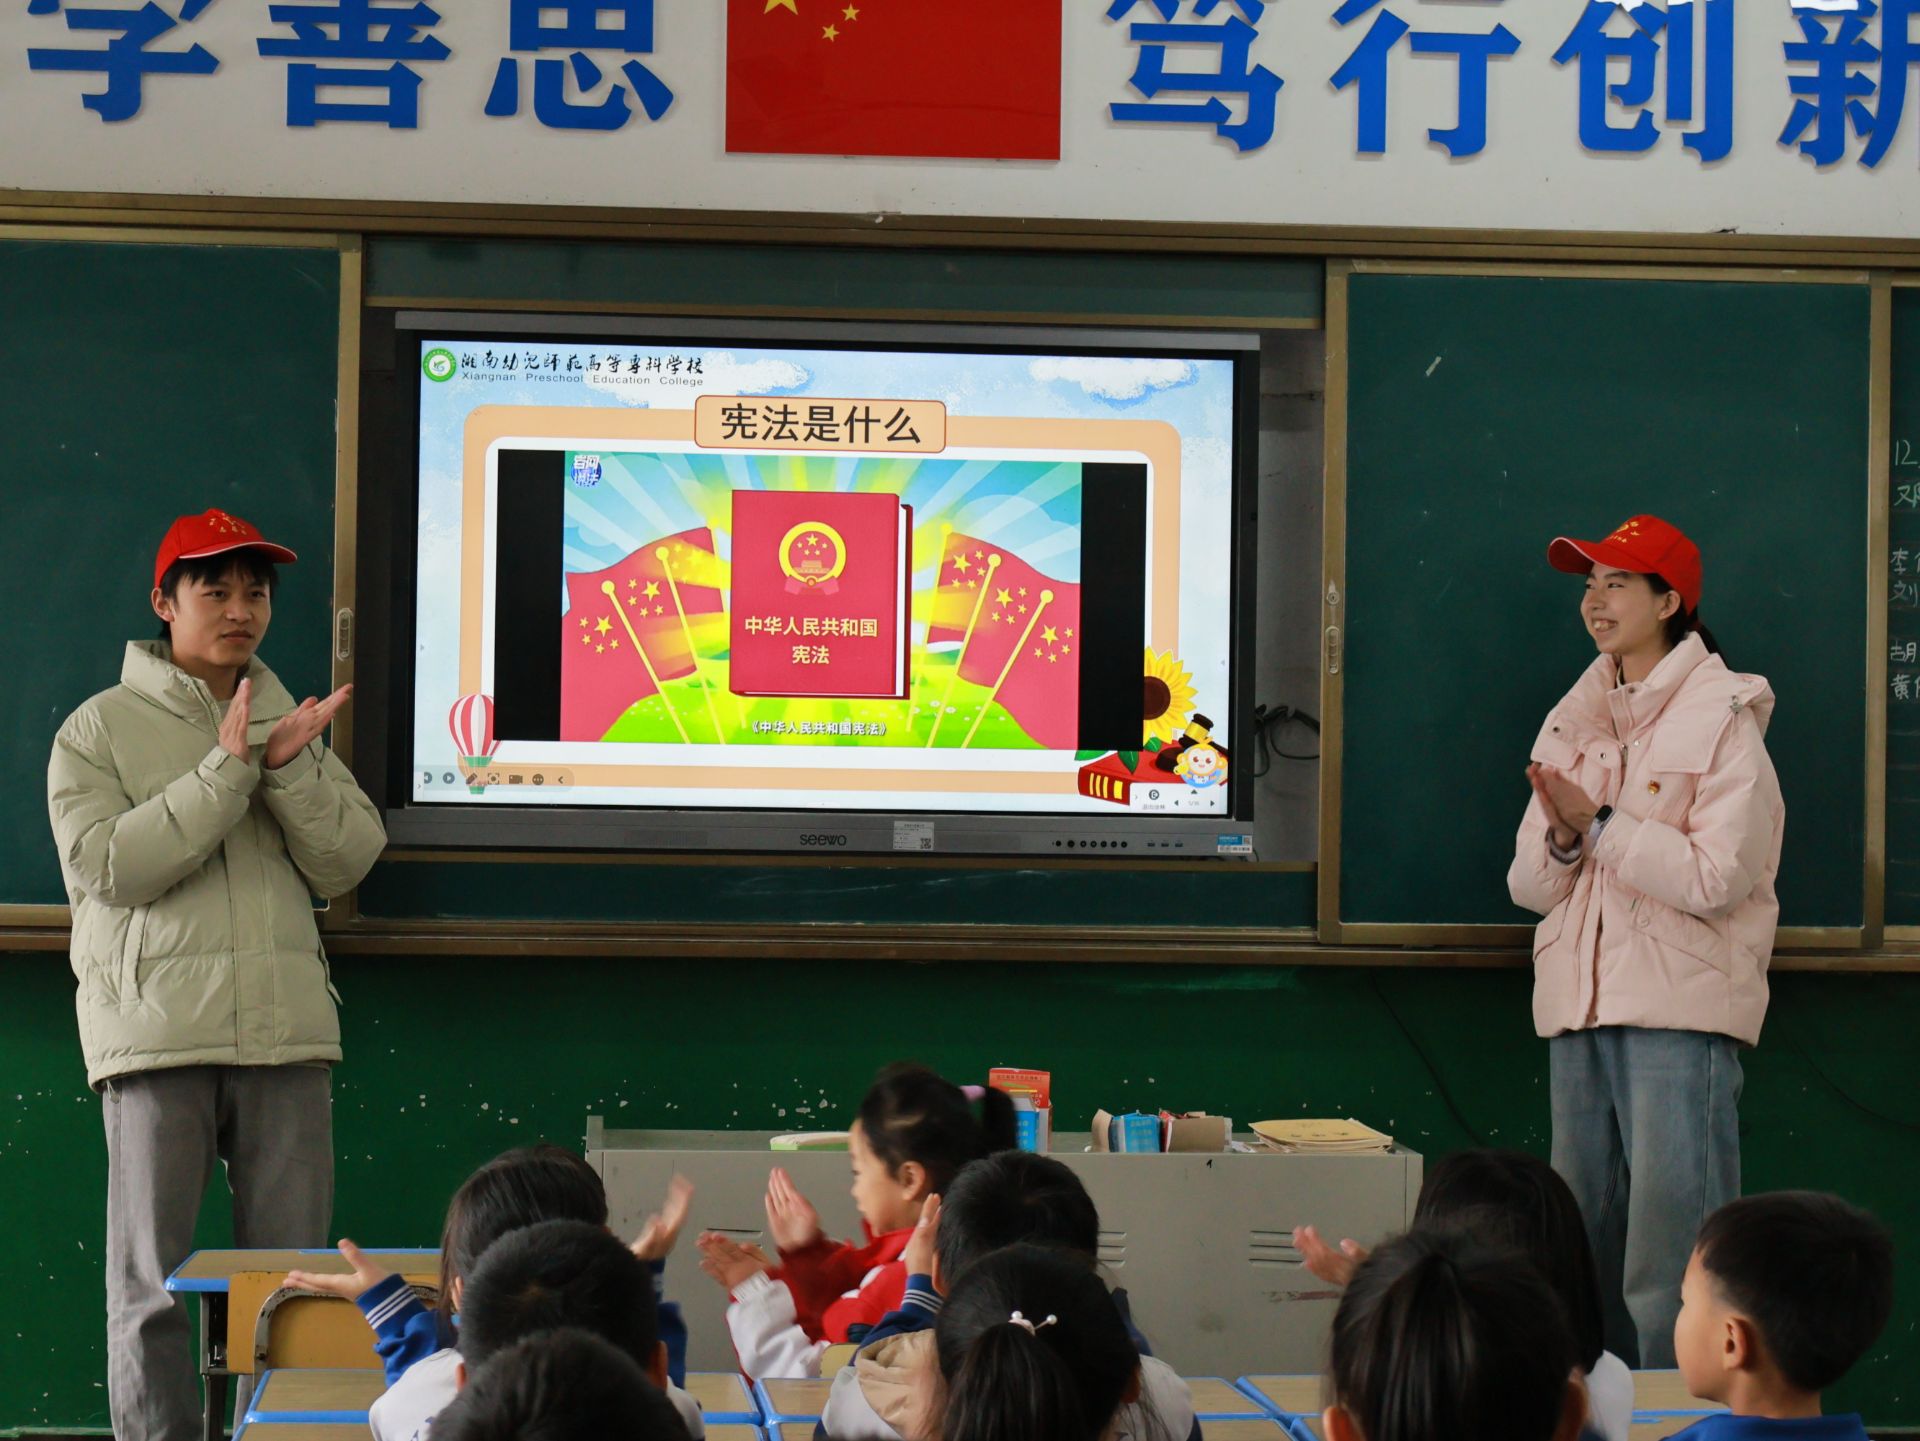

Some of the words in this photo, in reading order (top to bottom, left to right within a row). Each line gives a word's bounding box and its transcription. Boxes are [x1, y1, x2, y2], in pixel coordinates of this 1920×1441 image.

[462, 371, 517, 383] Xiangnan
[525, 373, 584, 383] Preschool
[593, 374, 650, 385] Education
[659, 375, 704, 387] College
[721, 402, 922, 445] 宪法是什么
[744, 616, 878, 637] 中华人民共和国
[792, 645, 830, 664] 宪法
[1890, 639, 1917, 663] 胡
[751, 720, 888, 736] 《中华人民共和国宪法》
[799, 834, 848, 846] seewo
